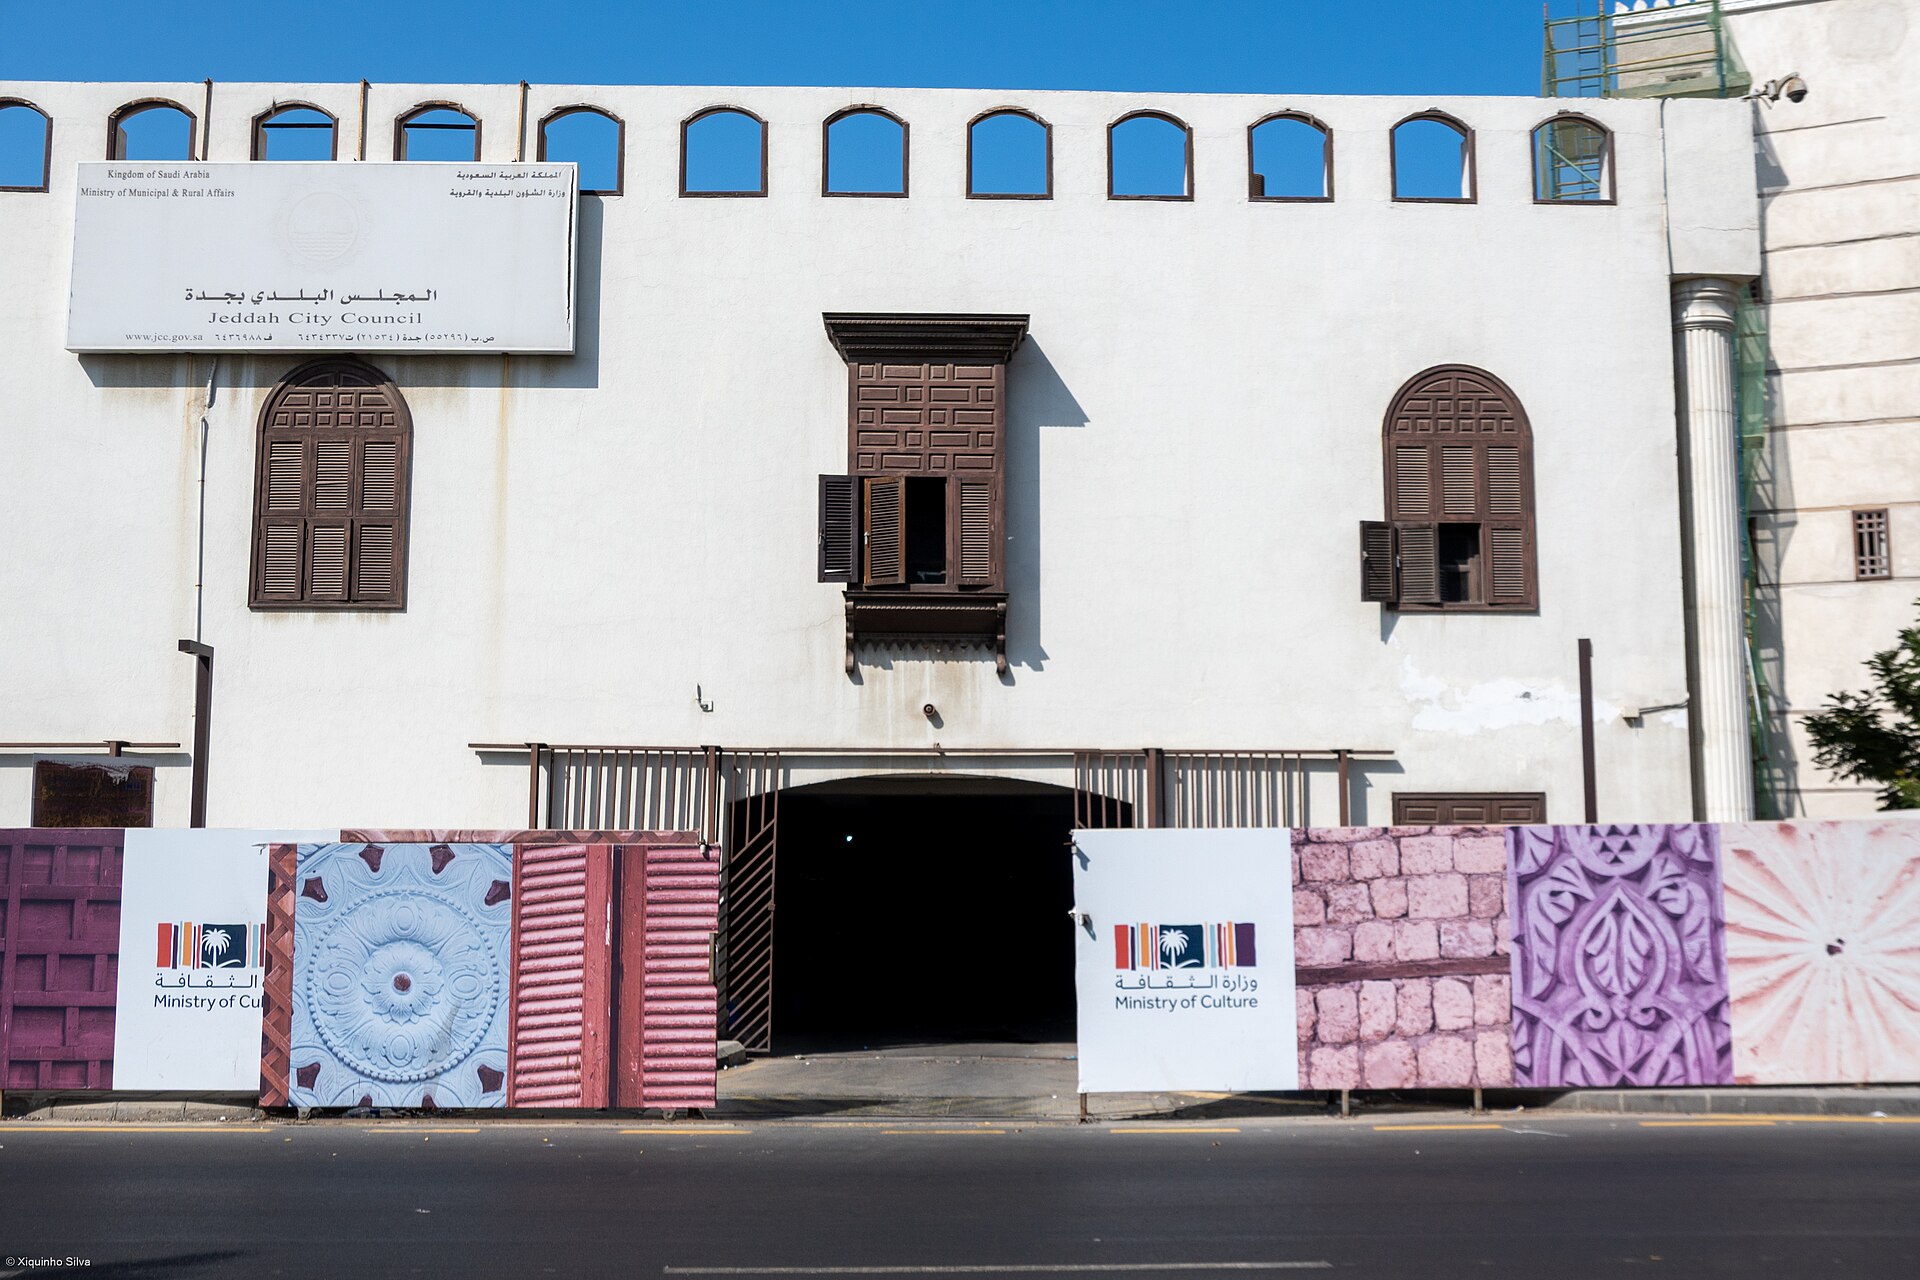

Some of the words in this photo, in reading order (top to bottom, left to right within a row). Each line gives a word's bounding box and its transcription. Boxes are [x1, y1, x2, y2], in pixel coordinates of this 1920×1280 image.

[107, 169, 145, 181] Kingdom
[146, 169, 157, 179] of
[157, 169, 181, 179] Saudi
[182, 169, 210, 179] Arabia
[456, 170, 497, 181] السعودية
[498, 170, 529, 181] العربية
[530, 171, 562, 179] المملكة
[80, 187, 116, 199] Ministry
[117, 187, 128, 197] of
[128, 188, 170, 200] Municipal
[171, 188, 179, 198] &
[181, 188, 204, 198] Rural
[206, 188, 235, 198] Affairs
[449, 188, 483, 199] والقروية
[484, 188, 514, 199] البلدية
[548, 188, 566, 198] وزارة
[208, 312, 280, 324] Jeddah
[288, 312, 333, 327] City
[340, 312, 421, 324] Council
[125, 332, 203, 344] www.jcc.gov.sa
[402, 333, 422, 343] جدة
[1222, 974, 1258, 993] وزارة
[153, 994, 217, 1012] Ministry
[218, 994, 237, 1009] of
[1115, 996, 1178, 1013] Ministry
[1180, 994, 1198, 1009] of
[1200, 994, 1258, 1009] Culture
